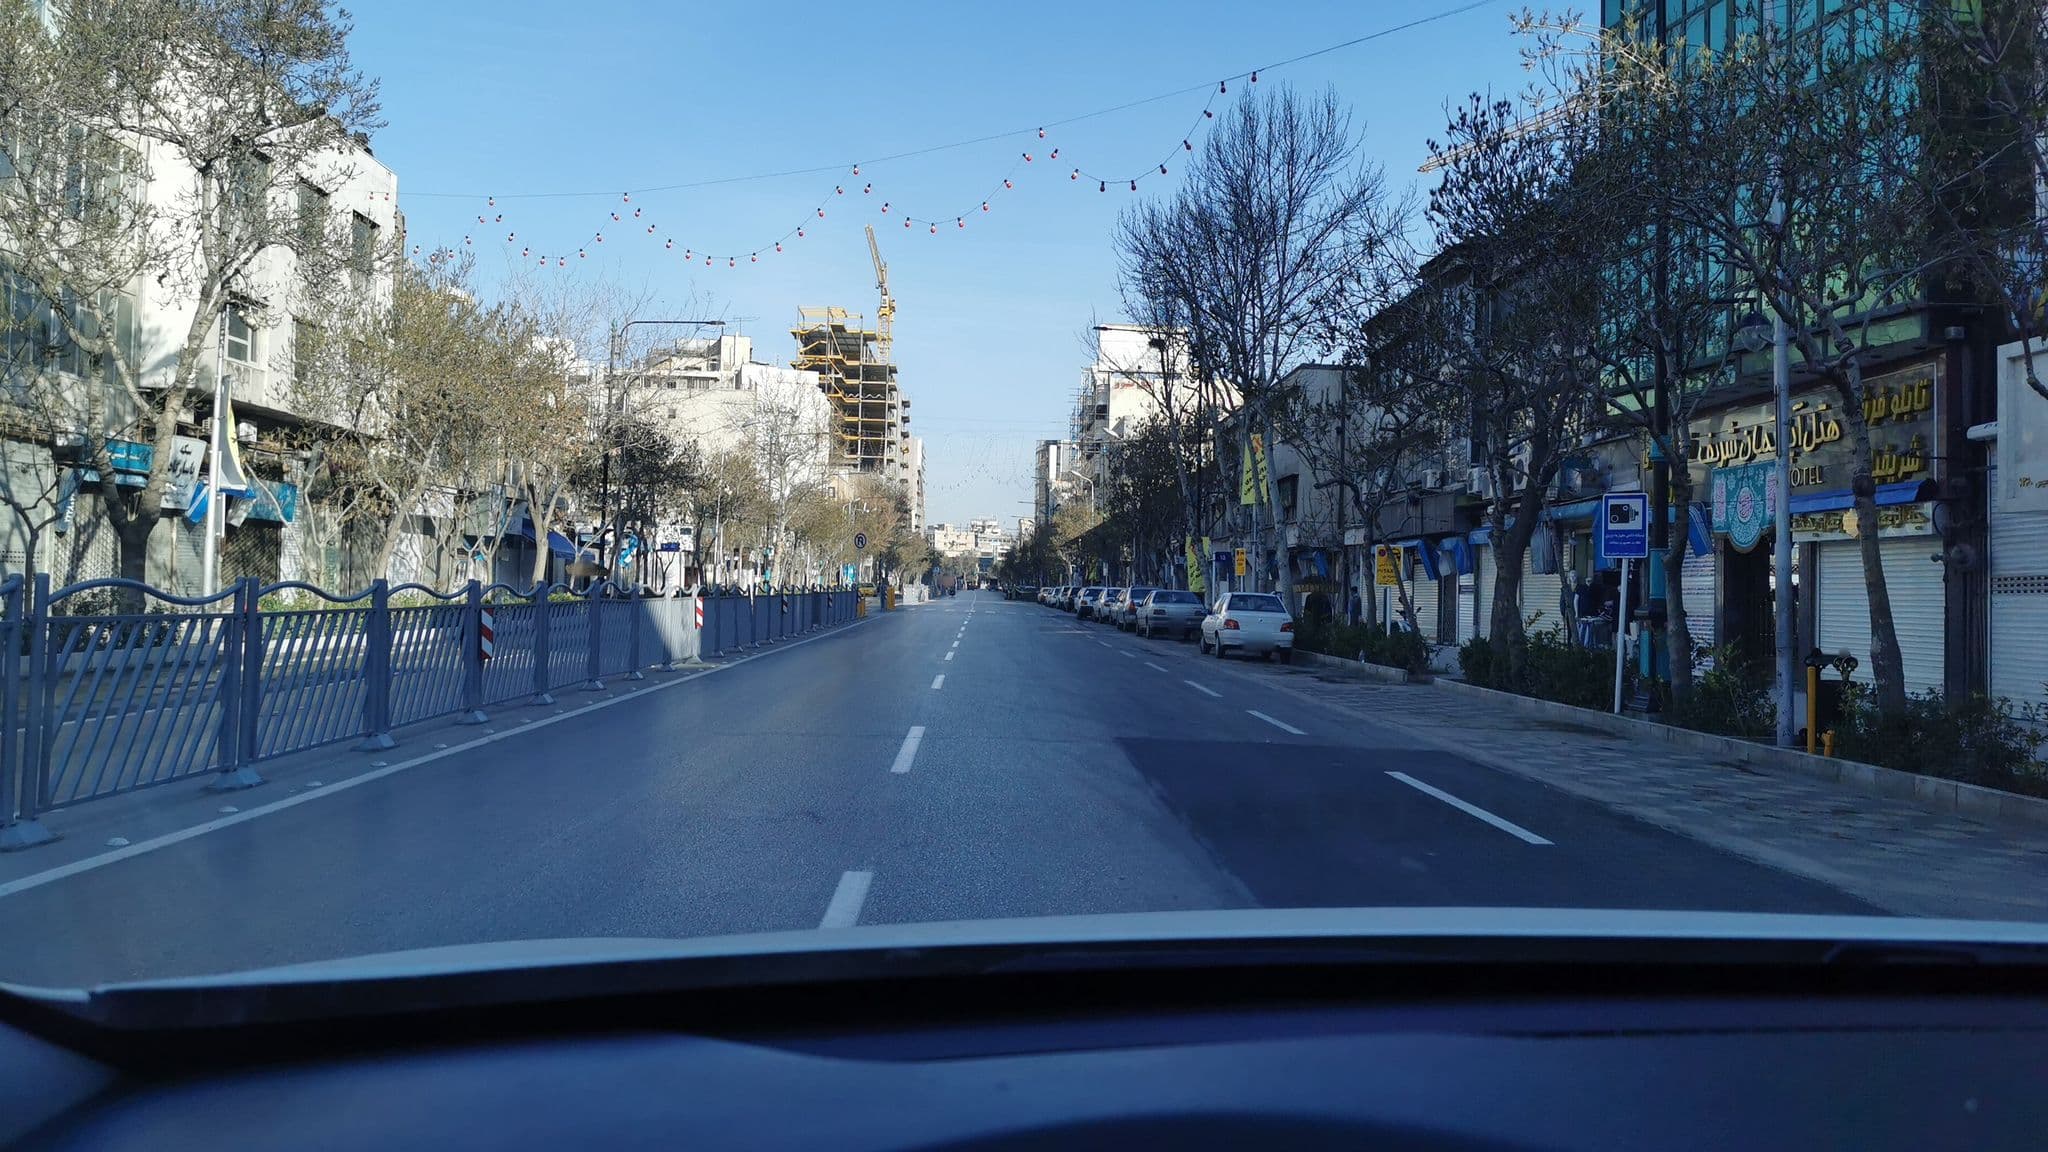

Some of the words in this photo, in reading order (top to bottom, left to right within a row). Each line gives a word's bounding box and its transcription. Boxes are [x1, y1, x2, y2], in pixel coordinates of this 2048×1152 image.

[1891, 378, 1930, 421] تابلو
[1697, 421, 1739, 467] شریف
[1803, 403, 1841, 452] هتل
[1789, 465, 1823, 487] OTEL
